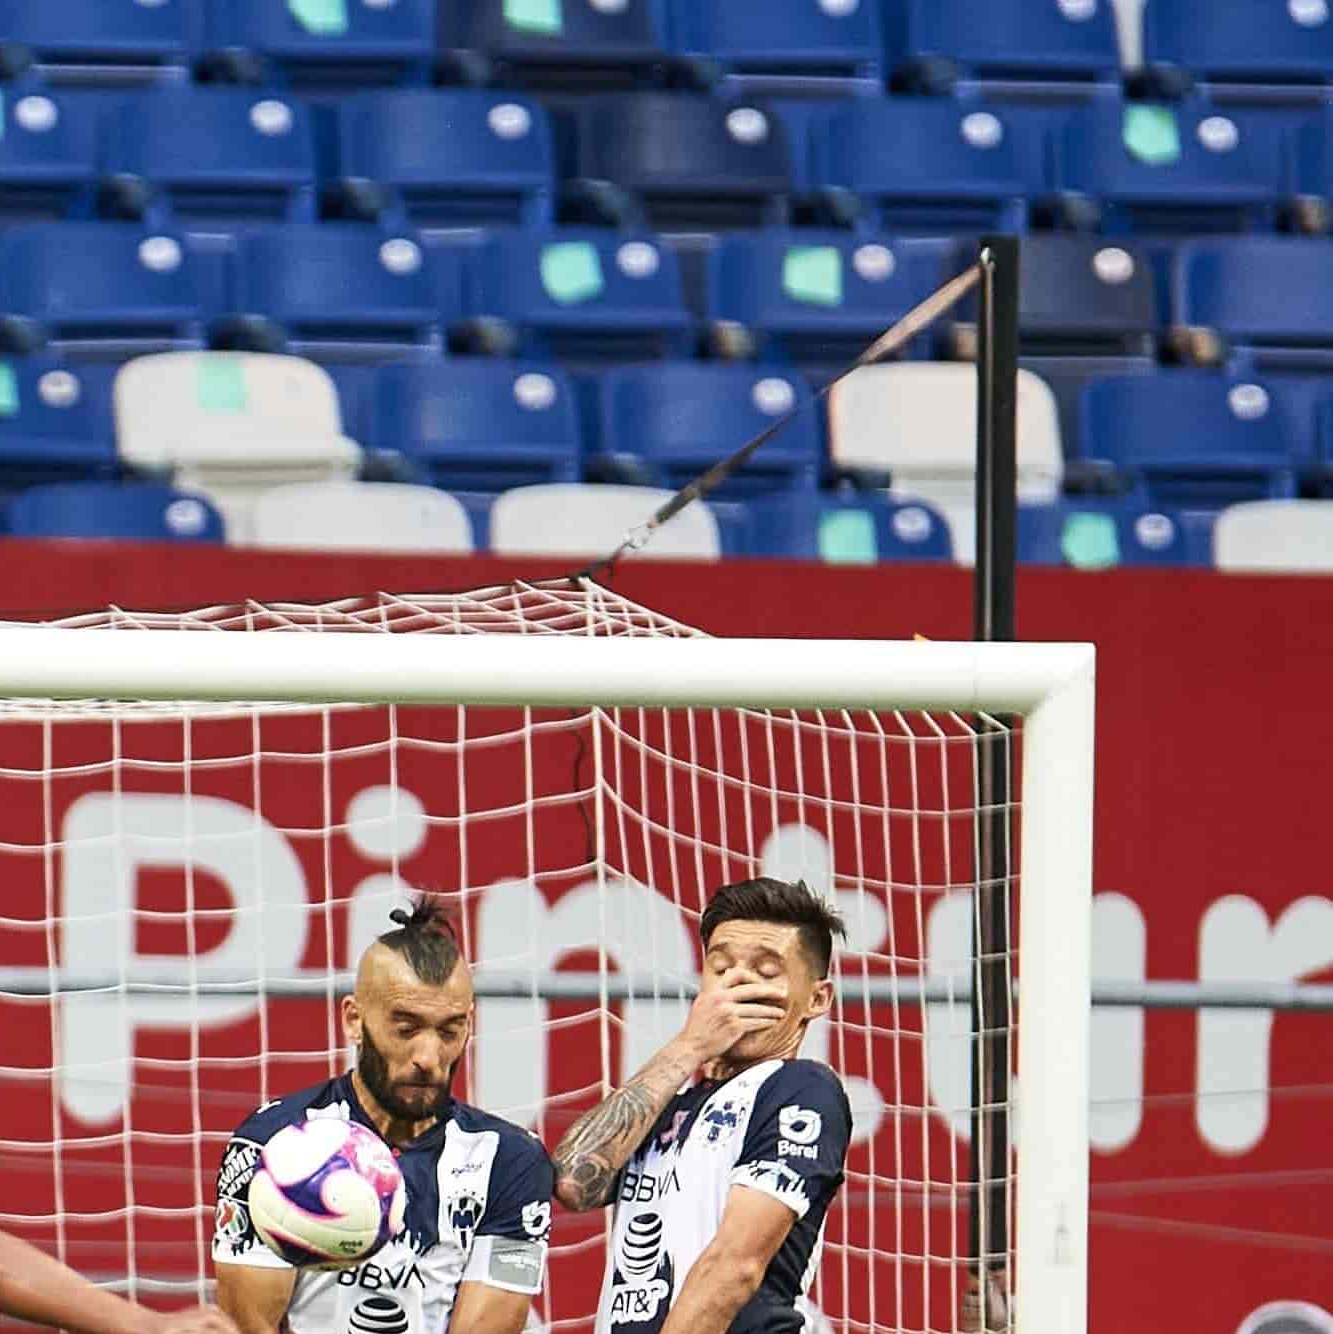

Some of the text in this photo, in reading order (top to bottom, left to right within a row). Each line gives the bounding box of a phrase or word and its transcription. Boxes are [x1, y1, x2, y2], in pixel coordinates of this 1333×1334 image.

[777, 1139, 819, 1160] Berel
[620, 1169, 682, 1204] BBVA
[336, 1261, 426, 1291] BBVA
